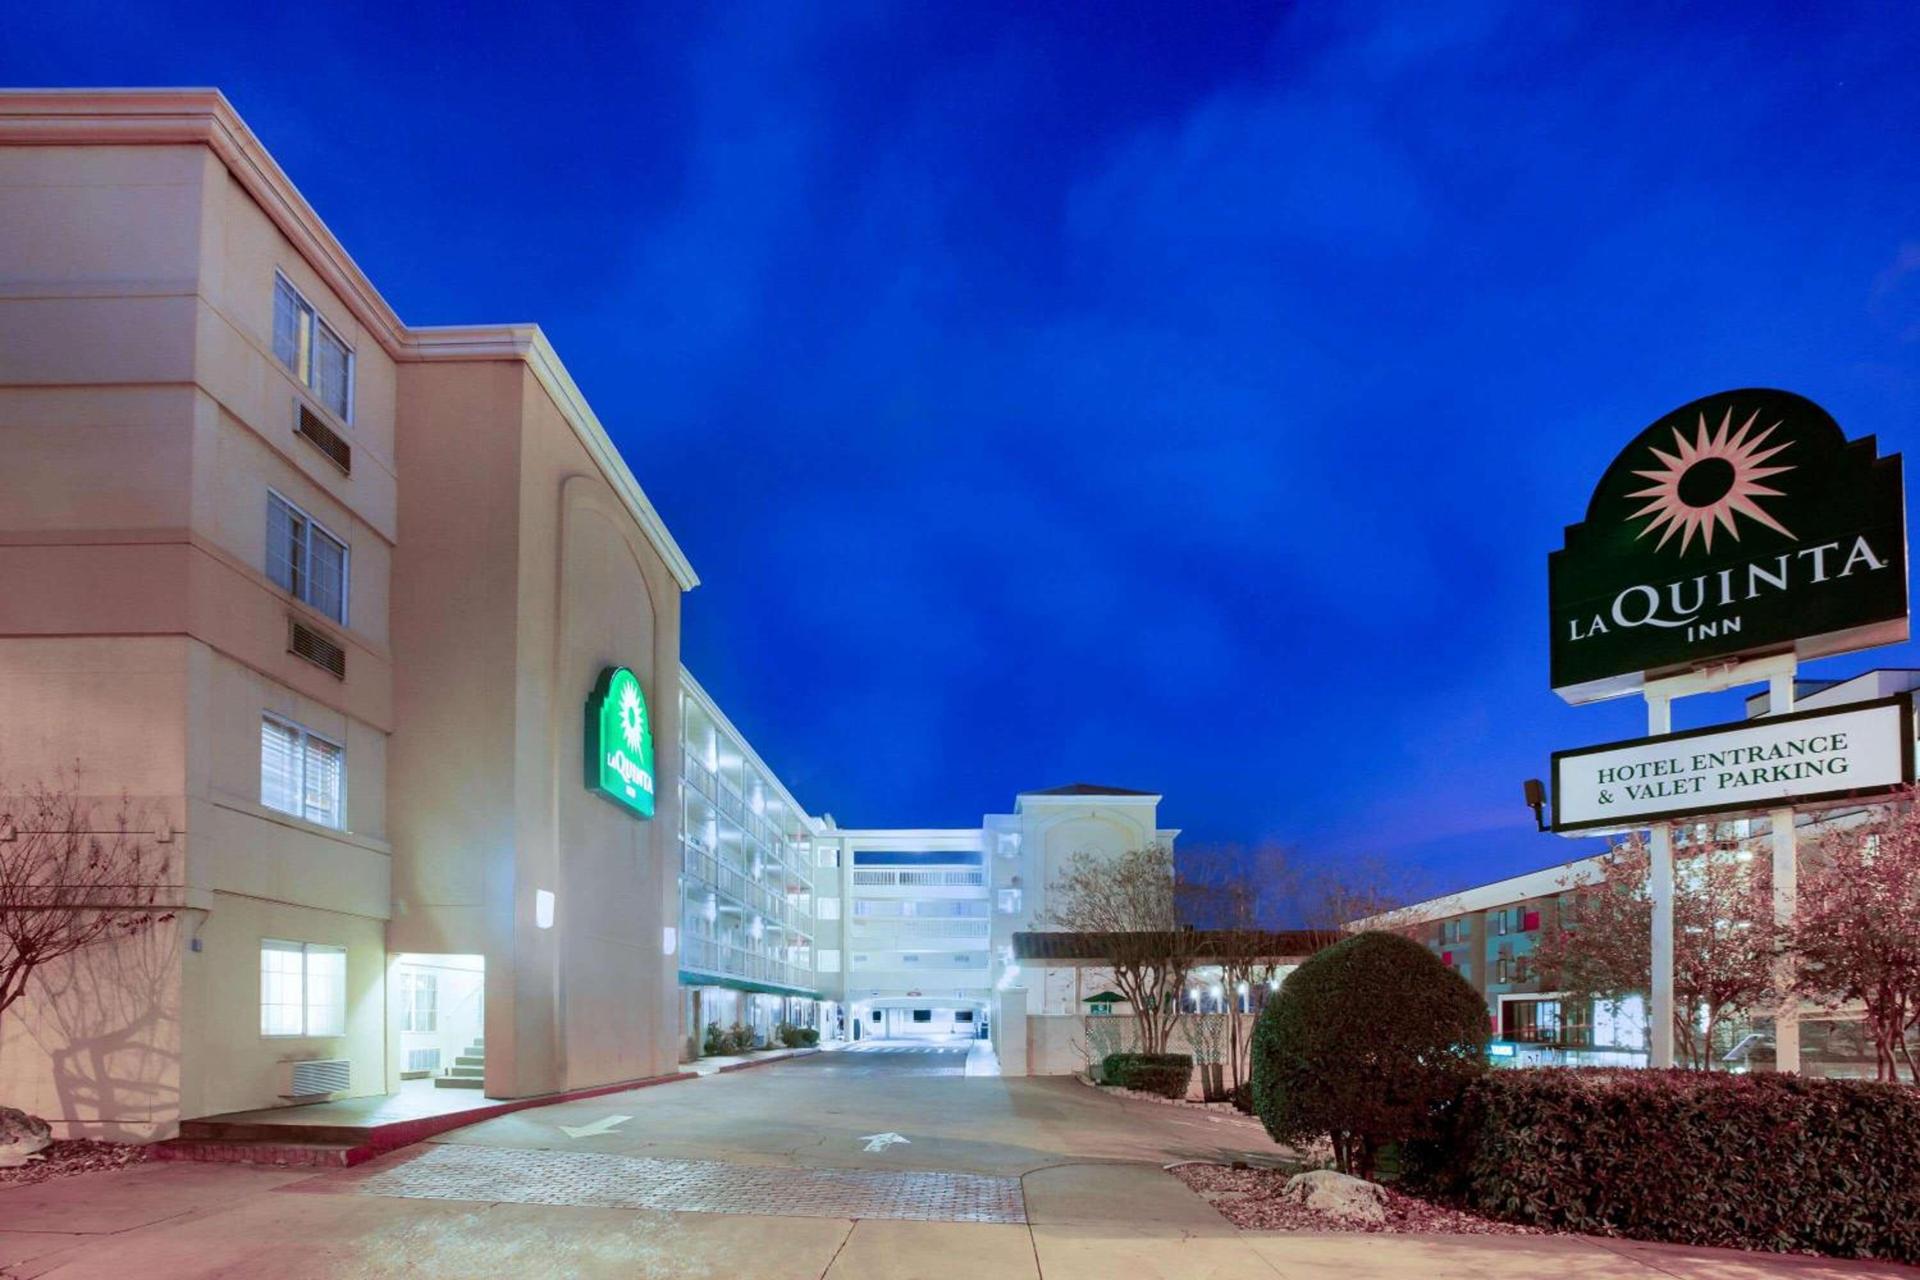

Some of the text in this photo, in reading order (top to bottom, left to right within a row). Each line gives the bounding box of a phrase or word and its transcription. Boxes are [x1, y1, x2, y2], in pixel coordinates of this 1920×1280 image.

[1569, 535, 1888, 641] LA QUINTA
[1688, 616, 1742, 642] INN
[1598, 733, 1848, 784] HOTEL ENTRANCE
[1598, 757, 1849, 805] & VALET PARKING
